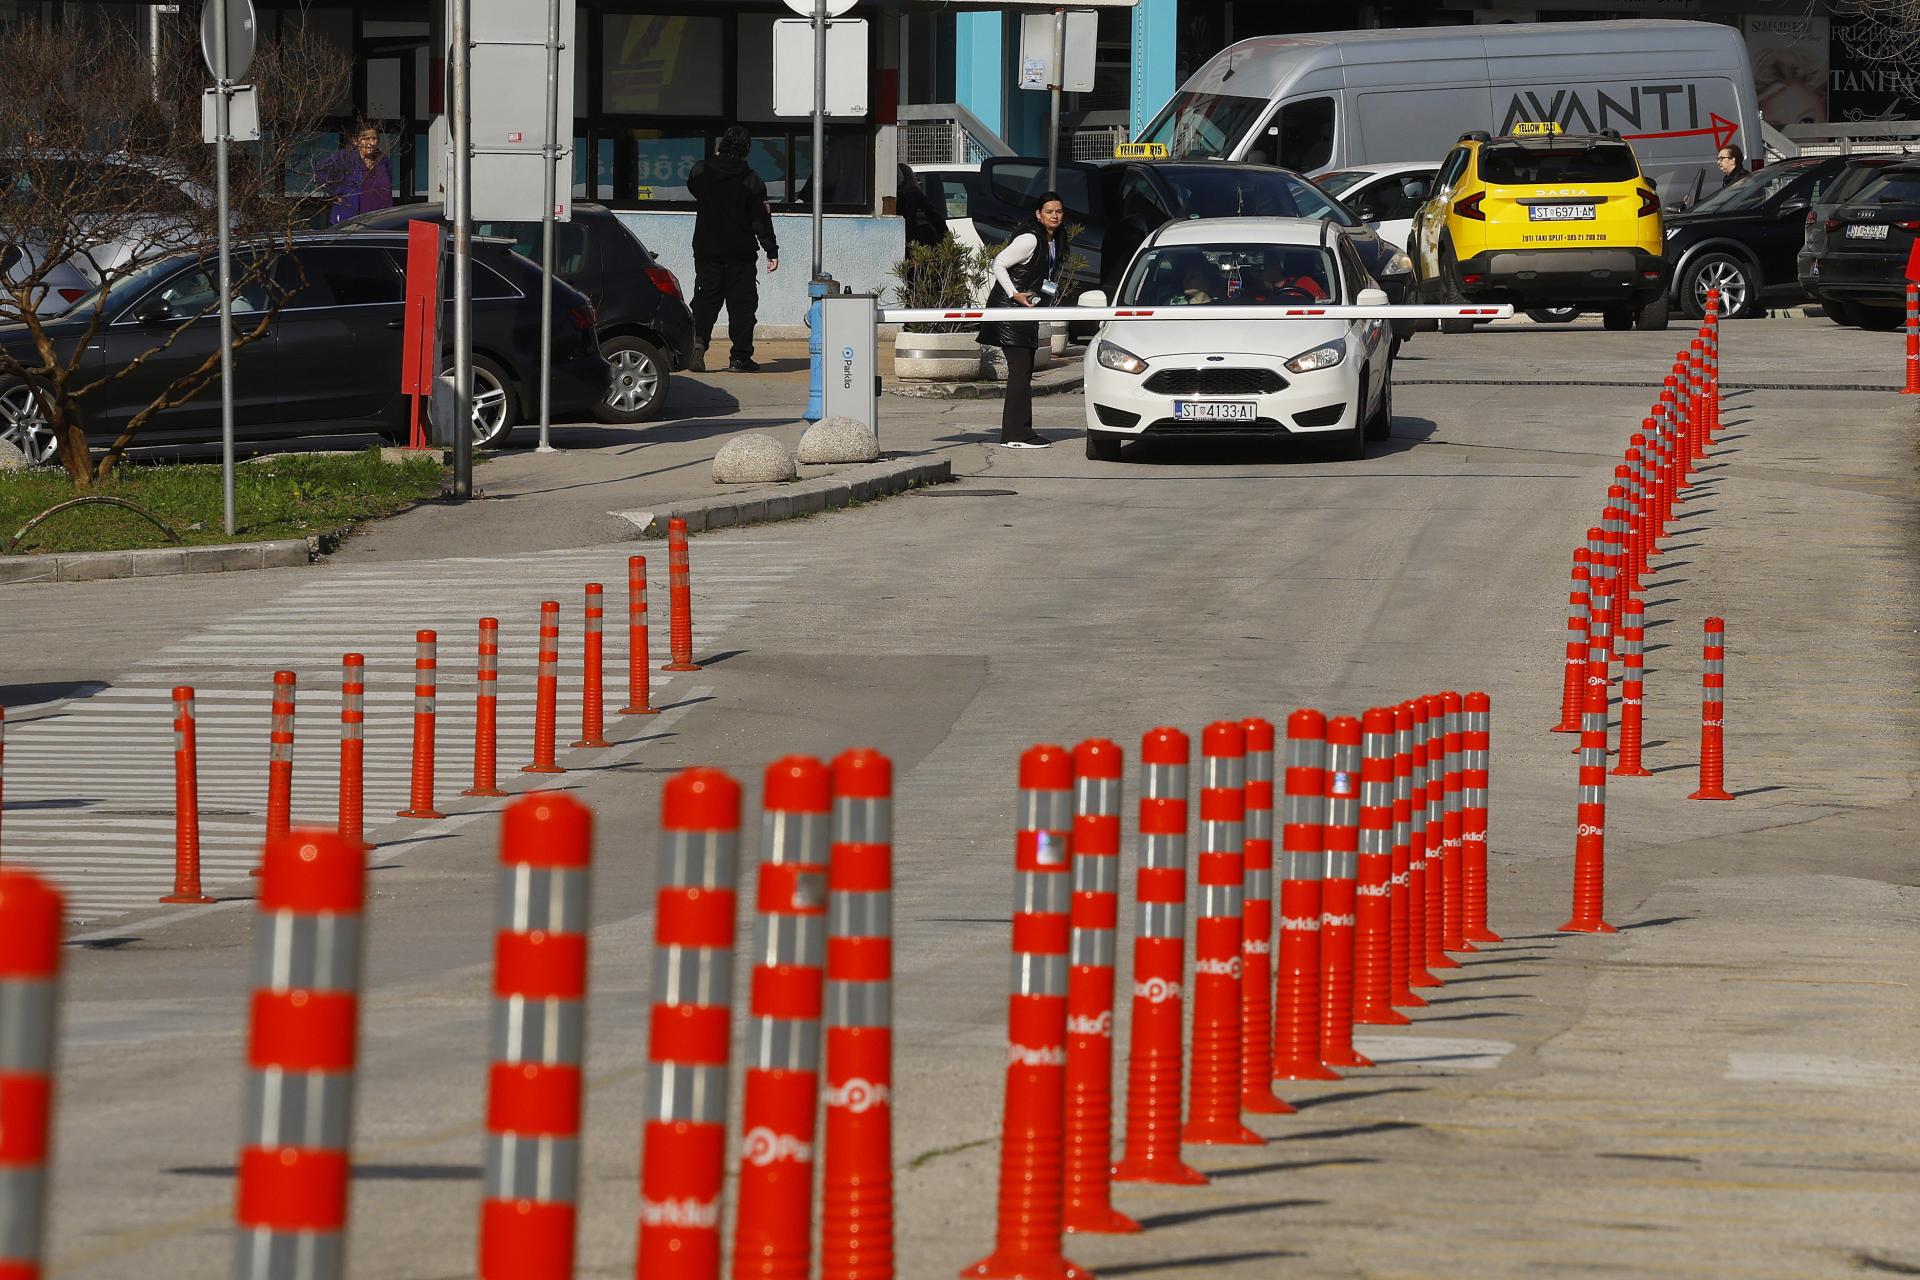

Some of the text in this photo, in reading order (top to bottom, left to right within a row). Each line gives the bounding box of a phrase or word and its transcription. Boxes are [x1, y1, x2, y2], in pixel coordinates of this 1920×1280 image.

[1830, 69, 1916, 93] TANITA
[1499, 84, 1699, 136] AVANTI
[1519, 123, 1540, 133] YELLOW
[1120, 145, 1146, 156] YELLOW
[1537, 207, 1549, 218] ST
[1535, 234, 1548, 242] TAXI
[1548, 234, 1563, 242] SPLIT
[843, 359, 853, 389] Parklio
[1183, 404, 1199, 417] ST
